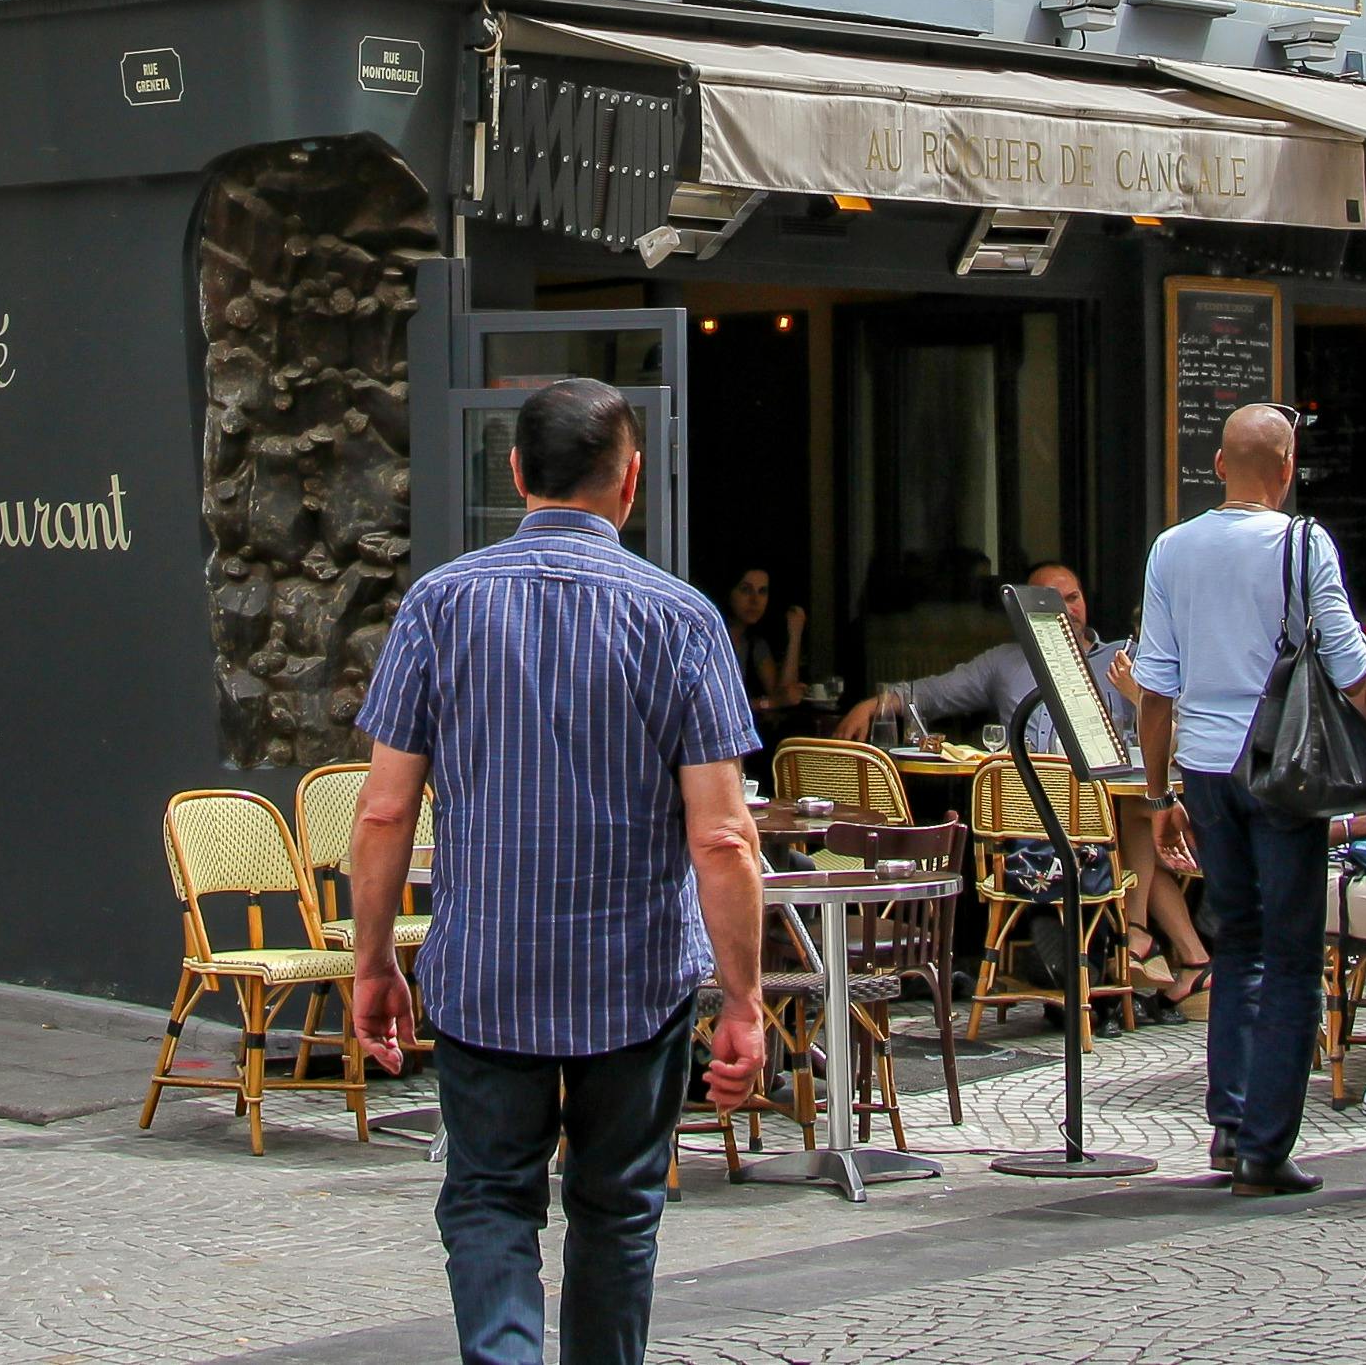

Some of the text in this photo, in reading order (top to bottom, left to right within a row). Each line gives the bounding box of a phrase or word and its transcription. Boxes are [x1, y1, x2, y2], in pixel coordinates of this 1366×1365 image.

[383, 51, 400, 65] RUE
[143, 63, 158, 76] RUE
[362, 65, 420, 83] MONTORGUEIL
[136, 78, 170, 93] GRENETA
[866, 128, 1247, 197] AU ROCHER DE CANCALE
